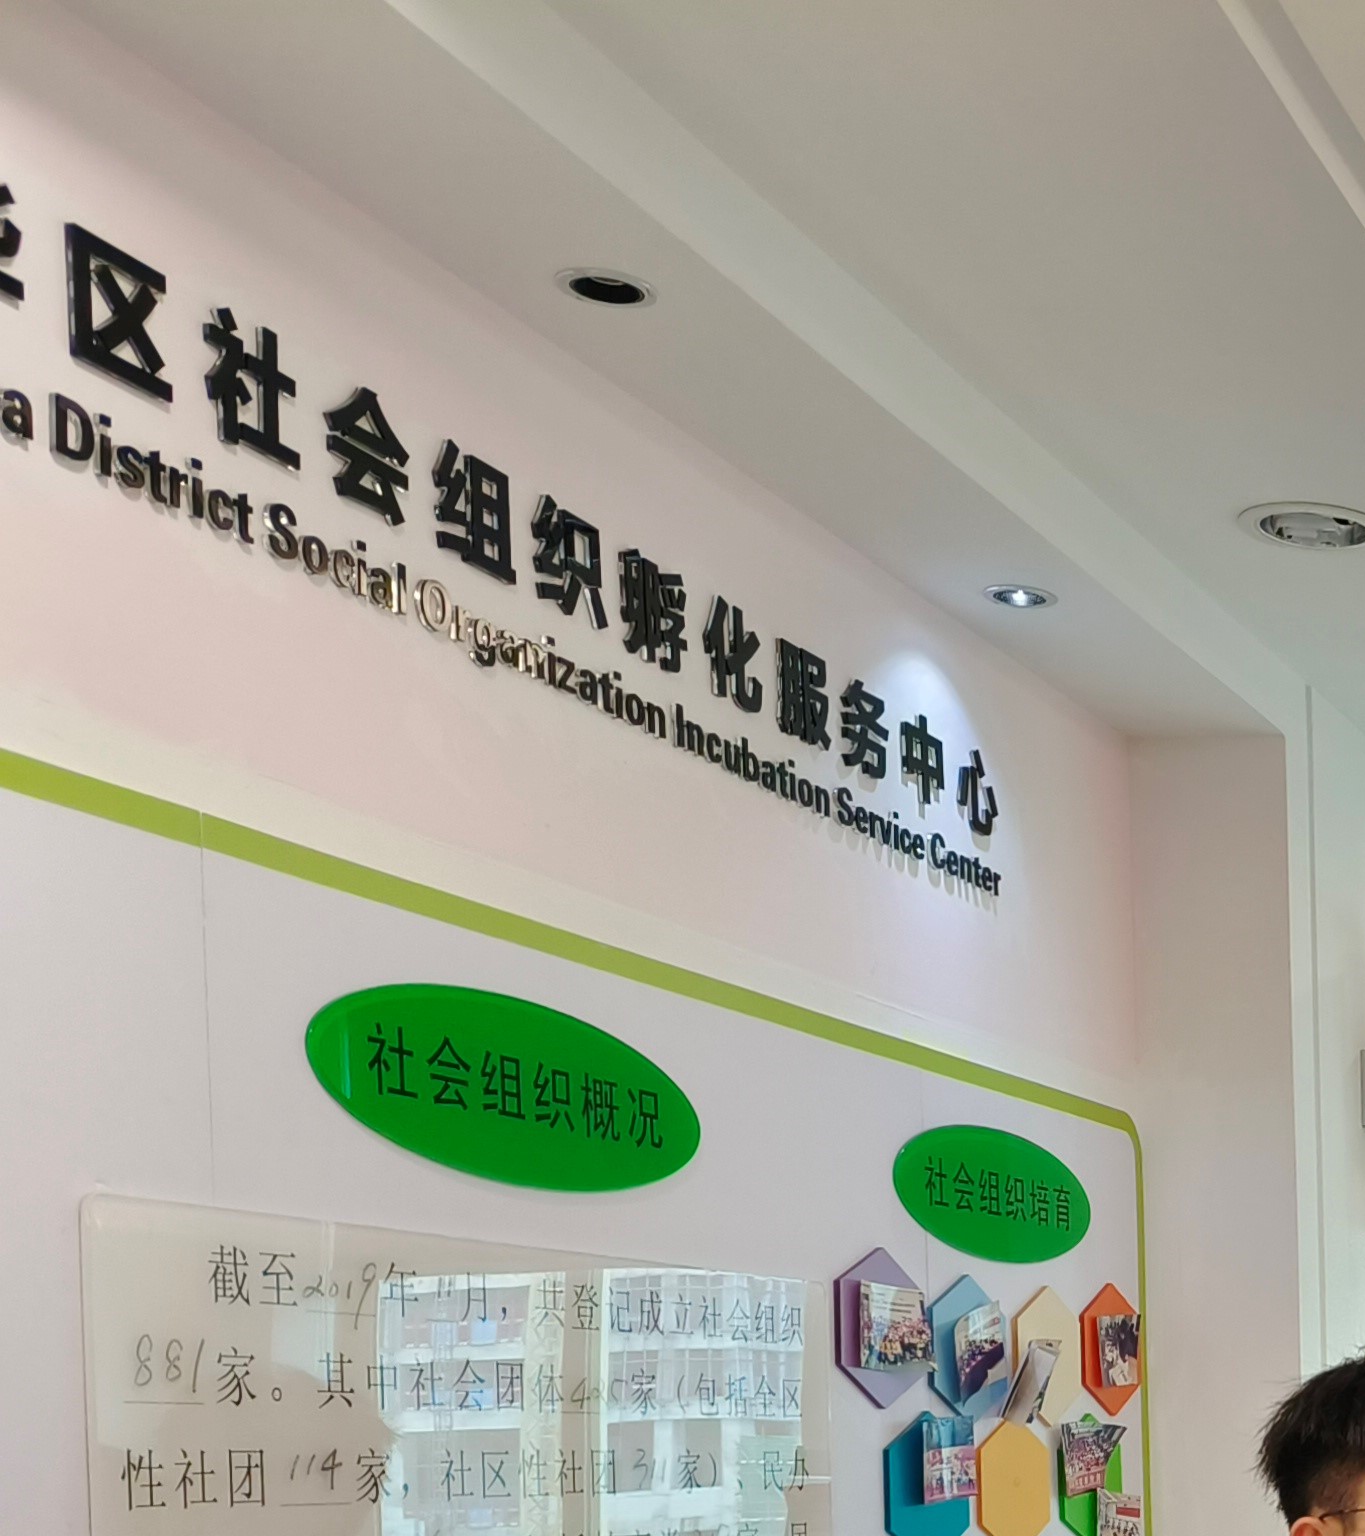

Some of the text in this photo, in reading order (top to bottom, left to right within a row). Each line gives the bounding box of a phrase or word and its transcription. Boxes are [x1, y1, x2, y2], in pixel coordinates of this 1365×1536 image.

[49, 392, 254, 545] District
[263, 501, 408, 616] Social
[414, 578, 666, 739] Organization
[672, 703, 831, 819] Incubation
[833, 786, 926, 862] Service
[926, 832, 1002, 898] Center
[366, 1022, 664, 1149] 社会组织概况
[924, 1155, 1071, 1232] 社会组织培育
